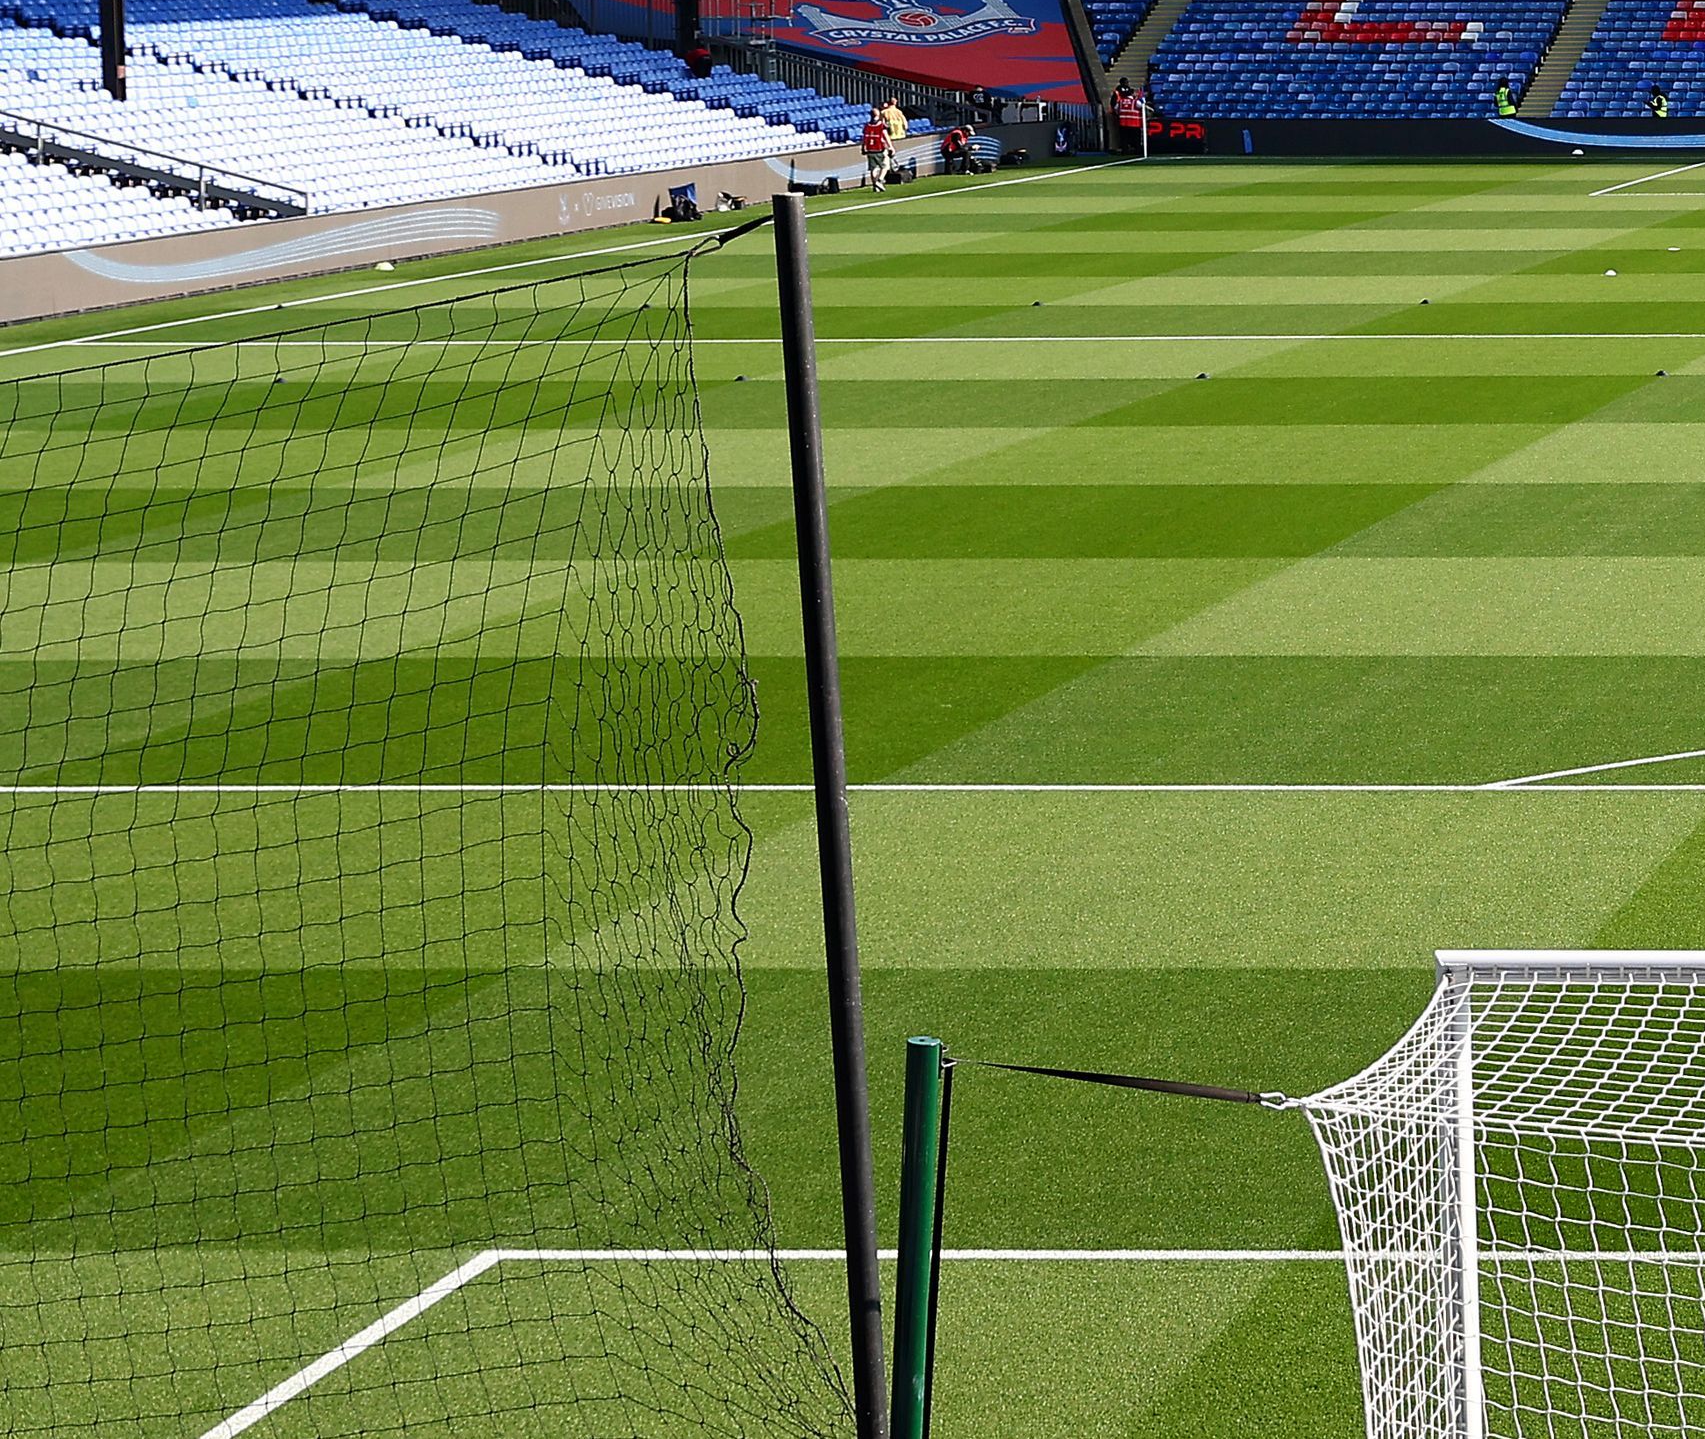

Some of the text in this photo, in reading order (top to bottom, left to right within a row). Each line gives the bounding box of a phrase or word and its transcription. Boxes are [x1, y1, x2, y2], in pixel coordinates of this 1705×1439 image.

[828, 17, 1023, 43] CRYSTAL PALACE F.C.
[1169, 122, 1206, 139] PR
